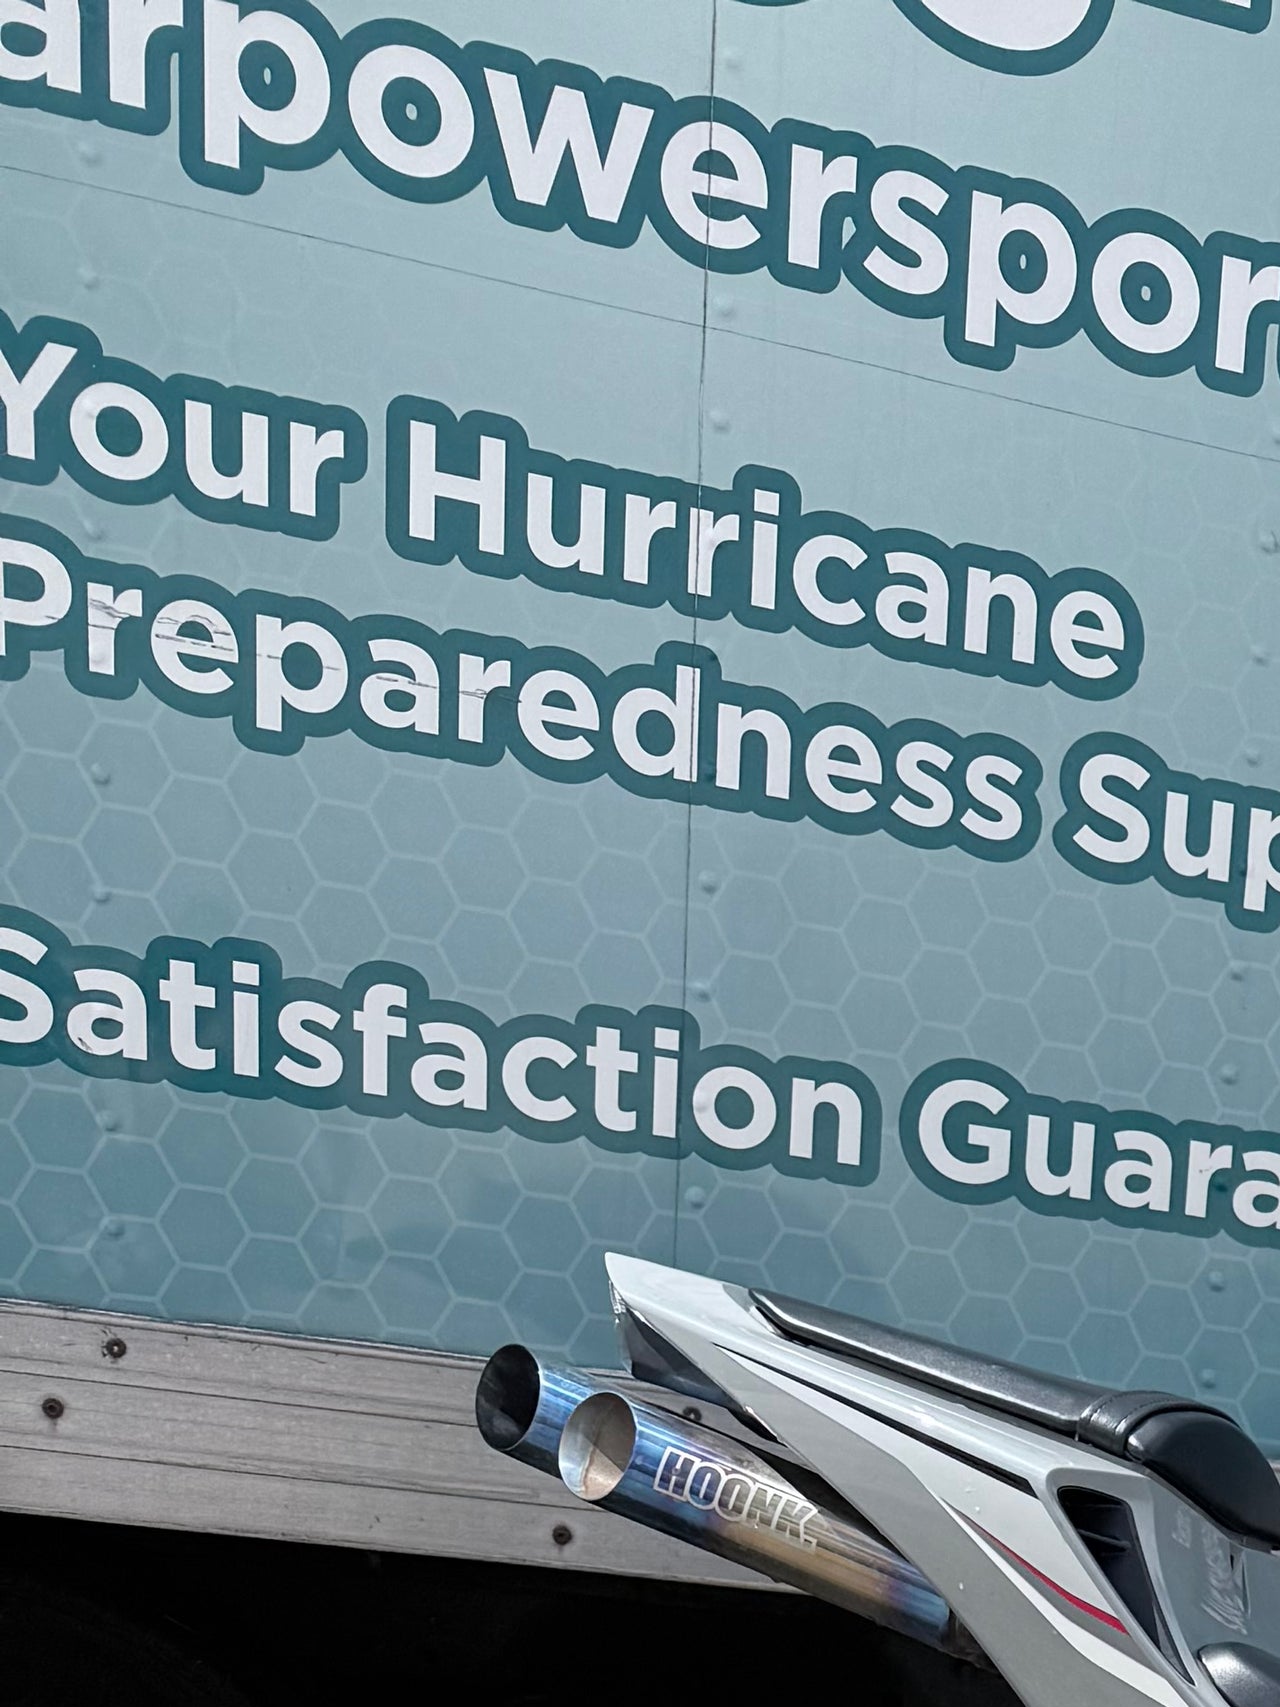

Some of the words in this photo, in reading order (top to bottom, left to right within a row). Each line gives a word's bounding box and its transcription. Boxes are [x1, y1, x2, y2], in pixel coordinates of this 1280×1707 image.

[0, 342, 345, 516] Your
[407, 420, 1126, 680] Hurricane
[0, 537, 1023, 842] Preparedness
[0, 926, 865, 1168] Satisfaction
